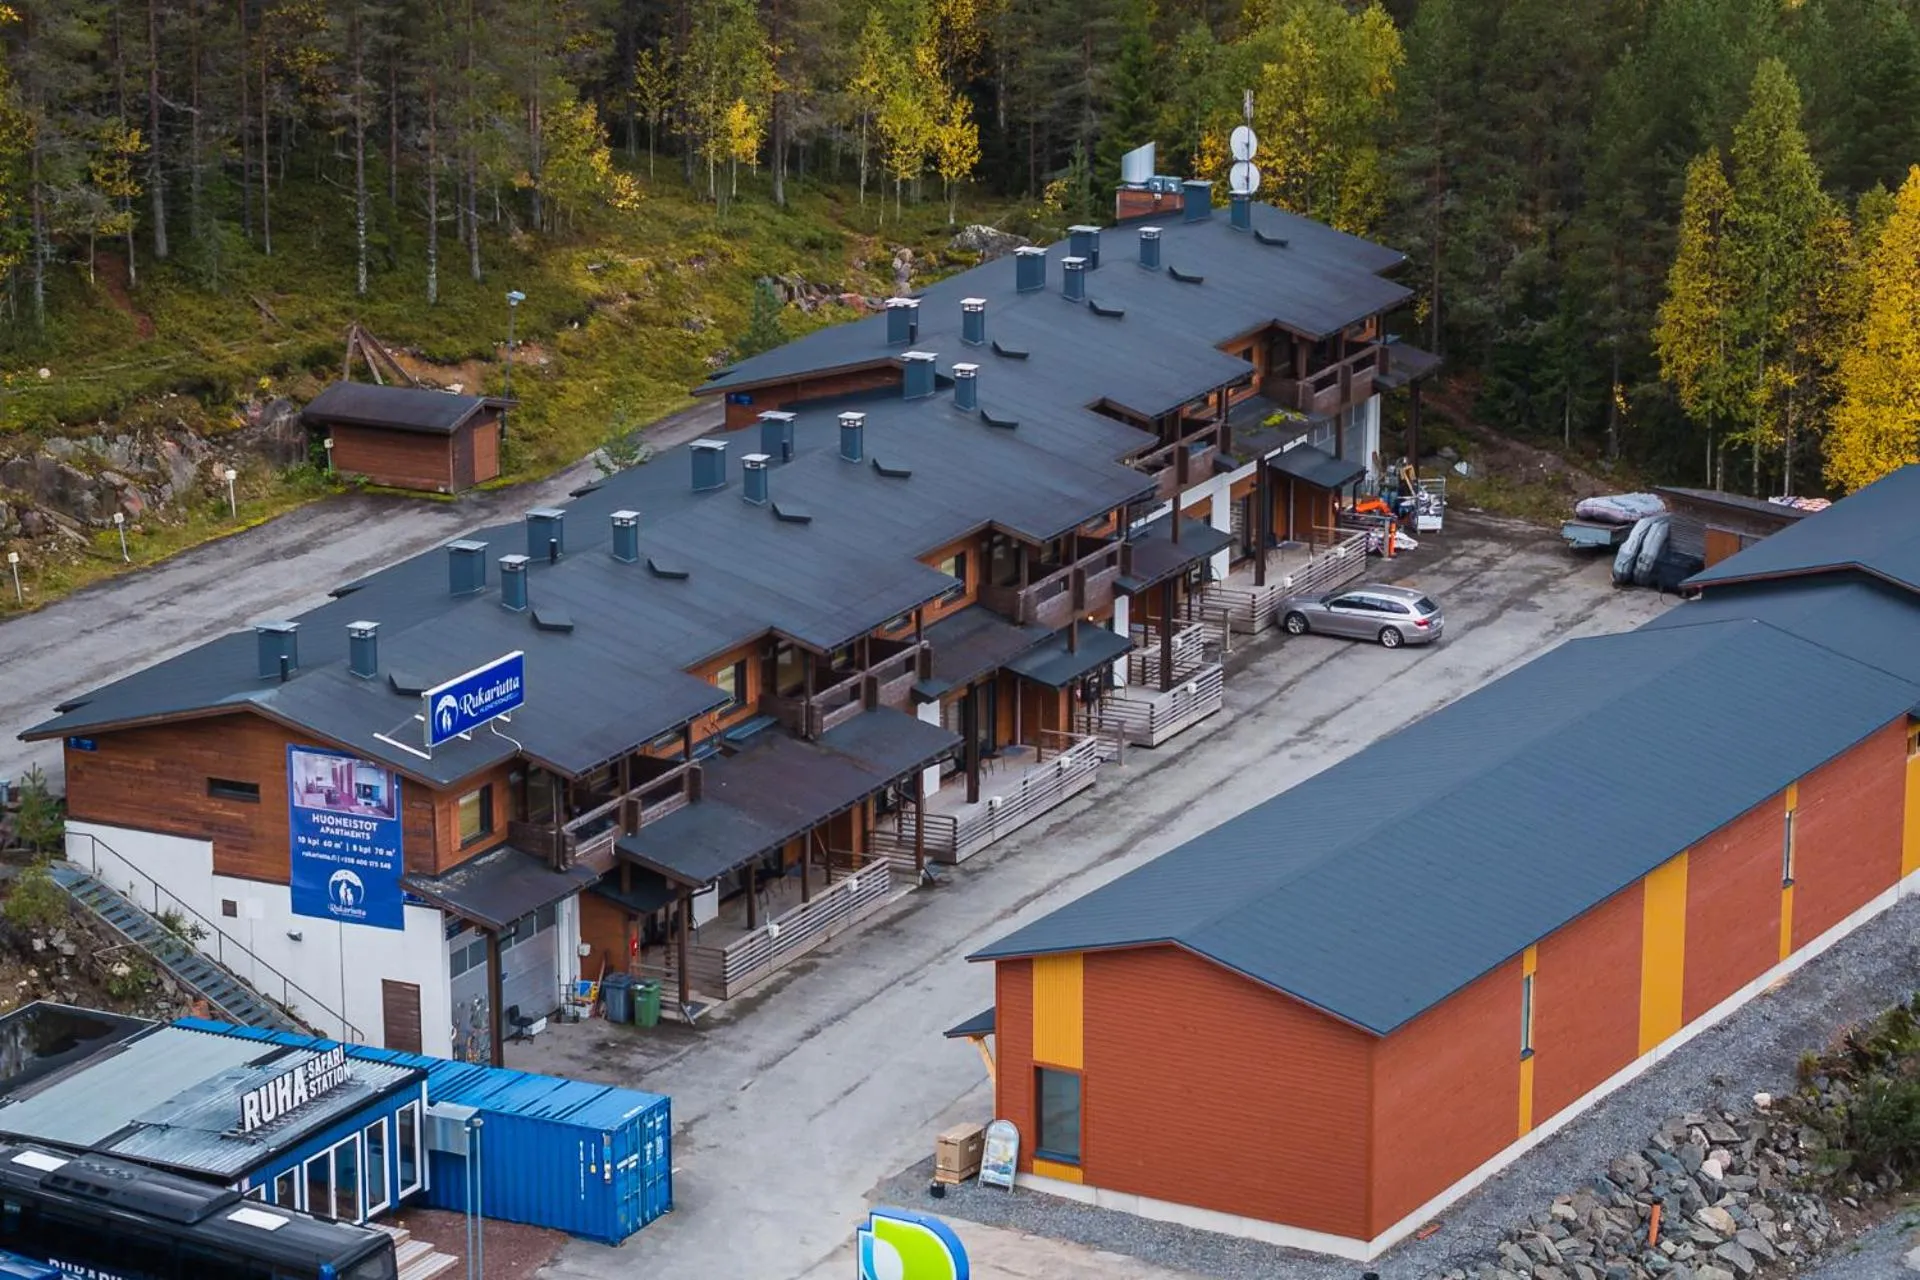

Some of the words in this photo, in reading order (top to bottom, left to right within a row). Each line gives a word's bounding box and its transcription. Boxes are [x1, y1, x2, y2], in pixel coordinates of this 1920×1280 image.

[459, 676, 520, 717] Rukariutta
[312, 813, 378, 831] HUONEISTOT
[320, 827, 370, 840] APARTMENTS
[297, 835, 307, 844] 10
[307, 836, 320, 847] kpl
[359, 845, 372, 855] kpl
[374, 846, 384, 855] 70
[307, 1044, 344, 1079] SAFARI
[308, 1060, 352, 1098] STATION
[242, 1065, 309, 1133] RUKA
